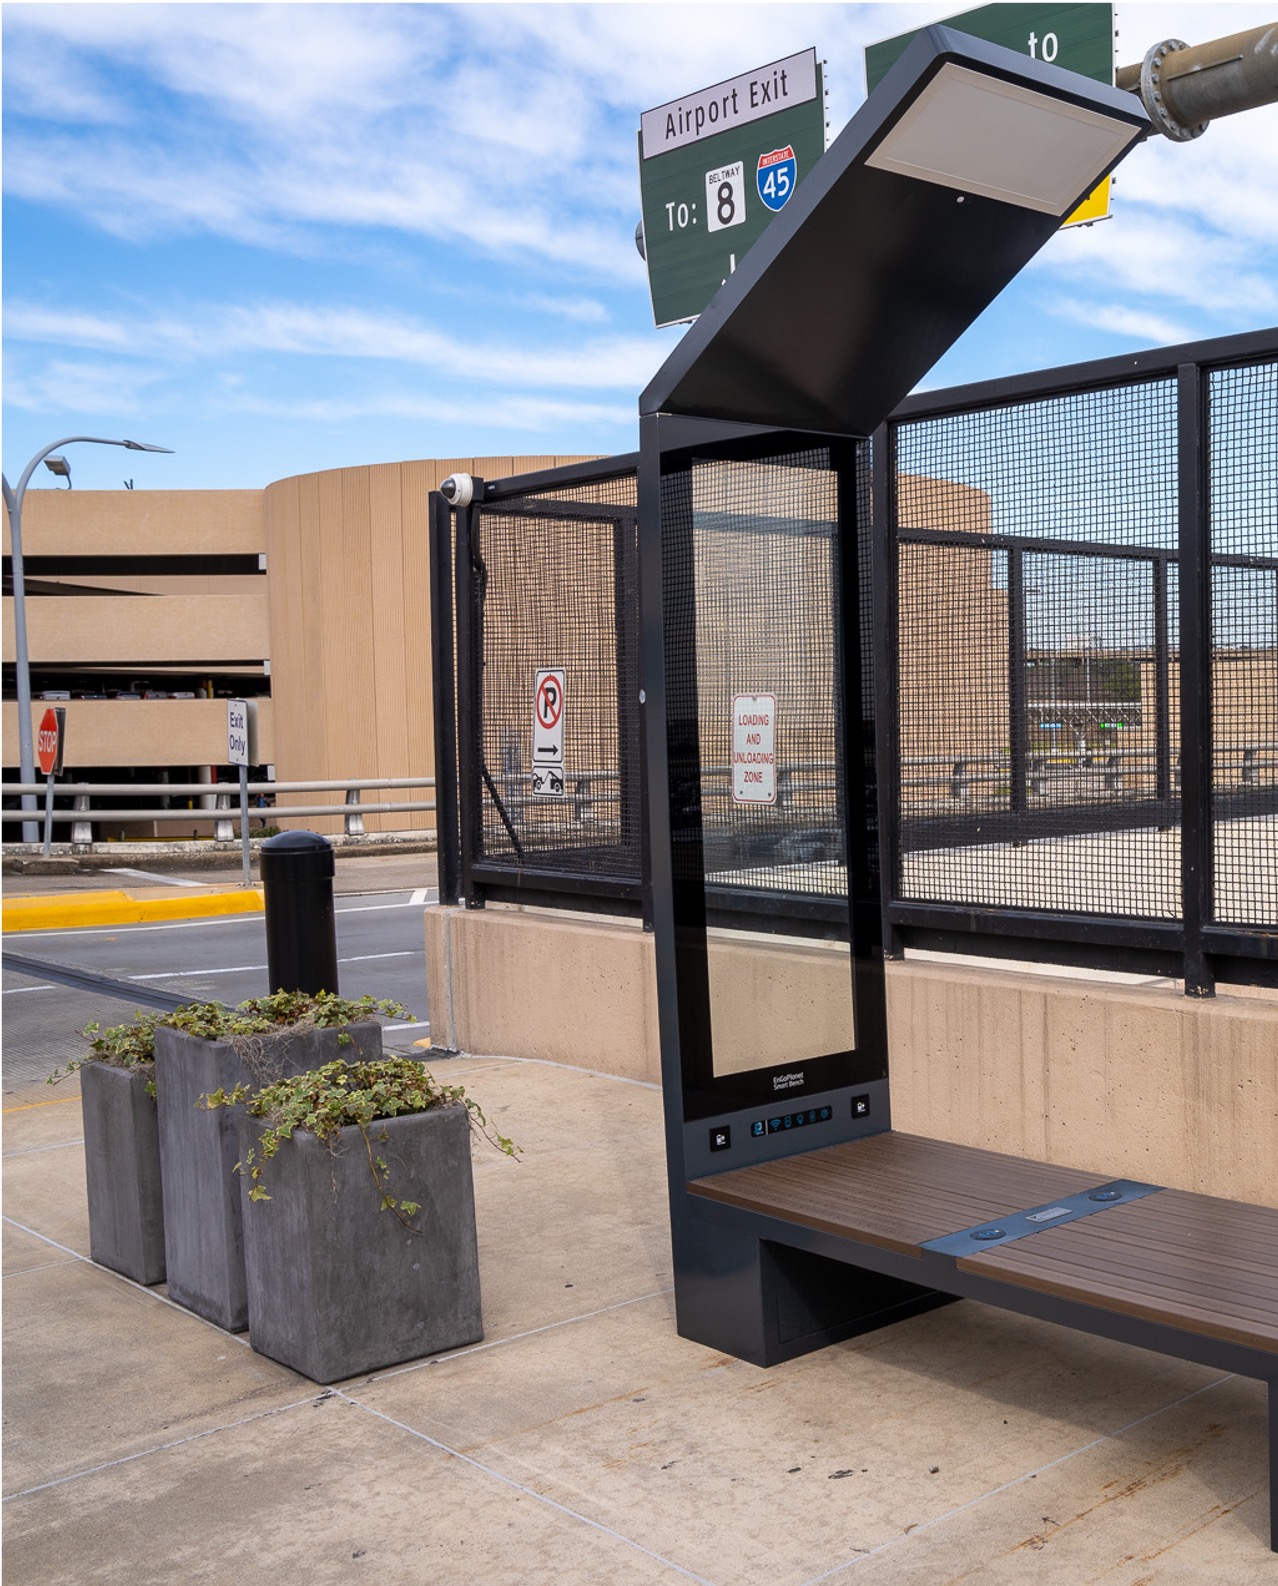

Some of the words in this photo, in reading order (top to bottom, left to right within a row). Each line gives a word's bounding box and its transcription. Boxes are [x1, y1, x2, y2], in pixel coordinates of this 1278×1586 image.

[1028, 31, 1058, 62] to
[665, 88, 738, 140] Airport
[749, 69, 788, 109] Exit
[762, 150, 790, 166] INTERSTATE
[708, 165, 740, 185] BELTWAY
[763, 167, 790, 199] 45
[717, 181, 735, 225] 8
[230, 712, 244, 729] Exit
[739, 714, 769, 726] LOADING
[38, 730, 57, 753] STOP
[229, 734, 246, 756] Only
[746, 733, 761, 745] AND
[734, 752, 774, 764] UNLOADING
[744, 771, 763, 783] ZONE
